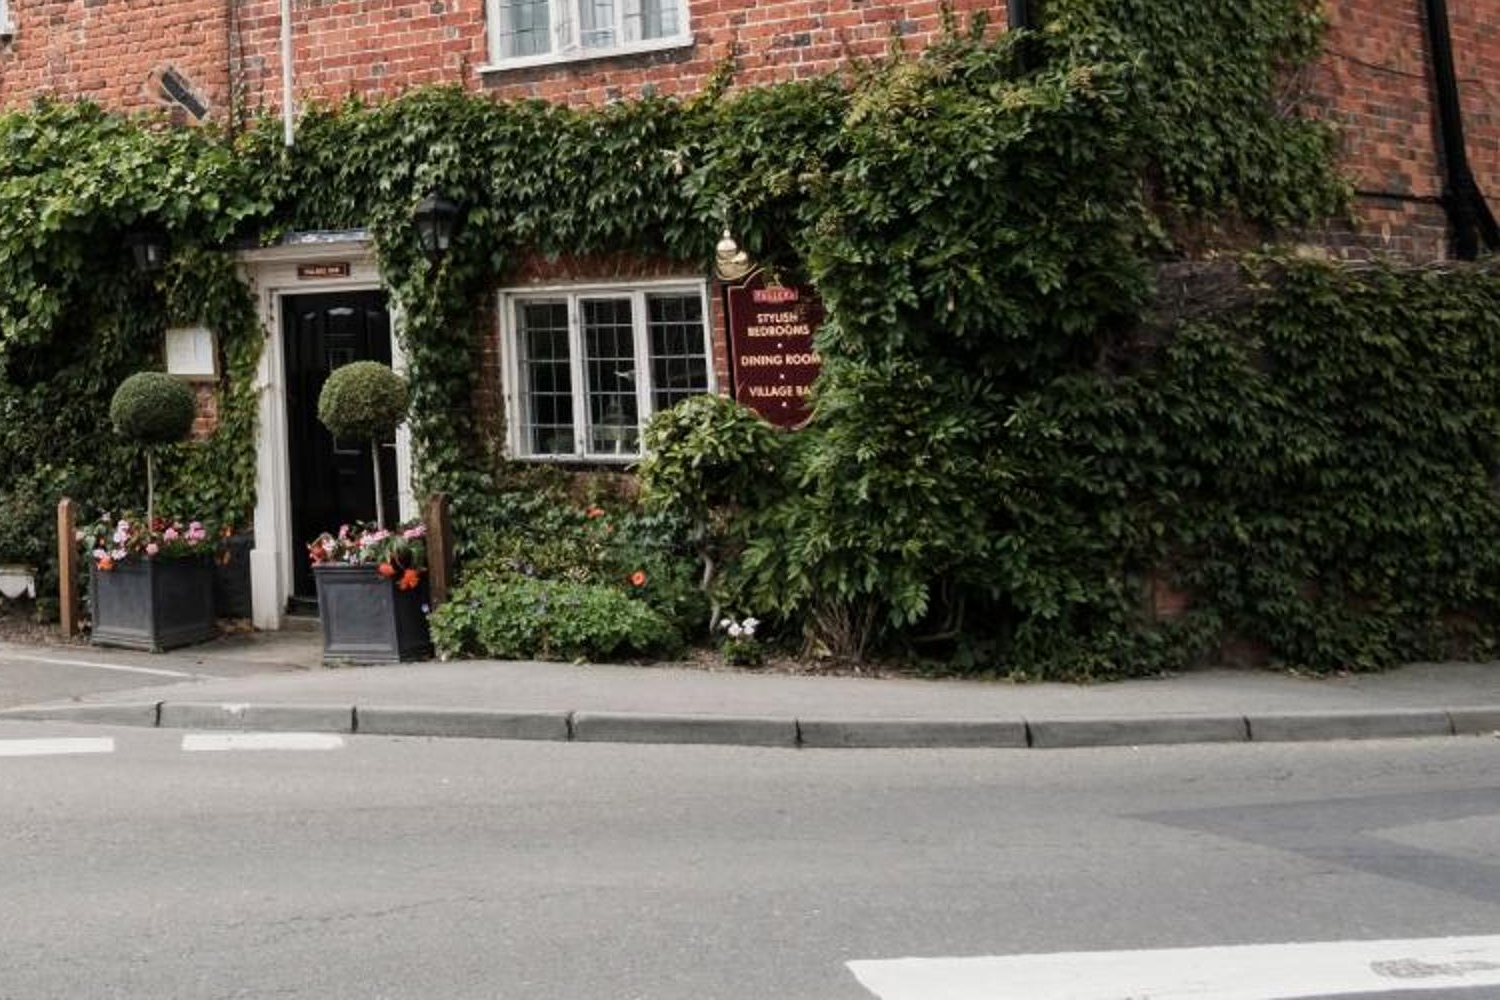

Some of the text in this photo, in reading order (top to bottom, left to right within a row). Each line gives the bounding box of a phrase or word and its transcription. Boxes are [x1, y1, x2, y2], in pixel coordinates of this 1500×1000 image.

[757, 313, 798, 323] STYLISH
[747, 325, 810, 337] BEDROOMS
[741, 355, 783, 367] DINING
[749, 385, 794, 398] VILLAGE
